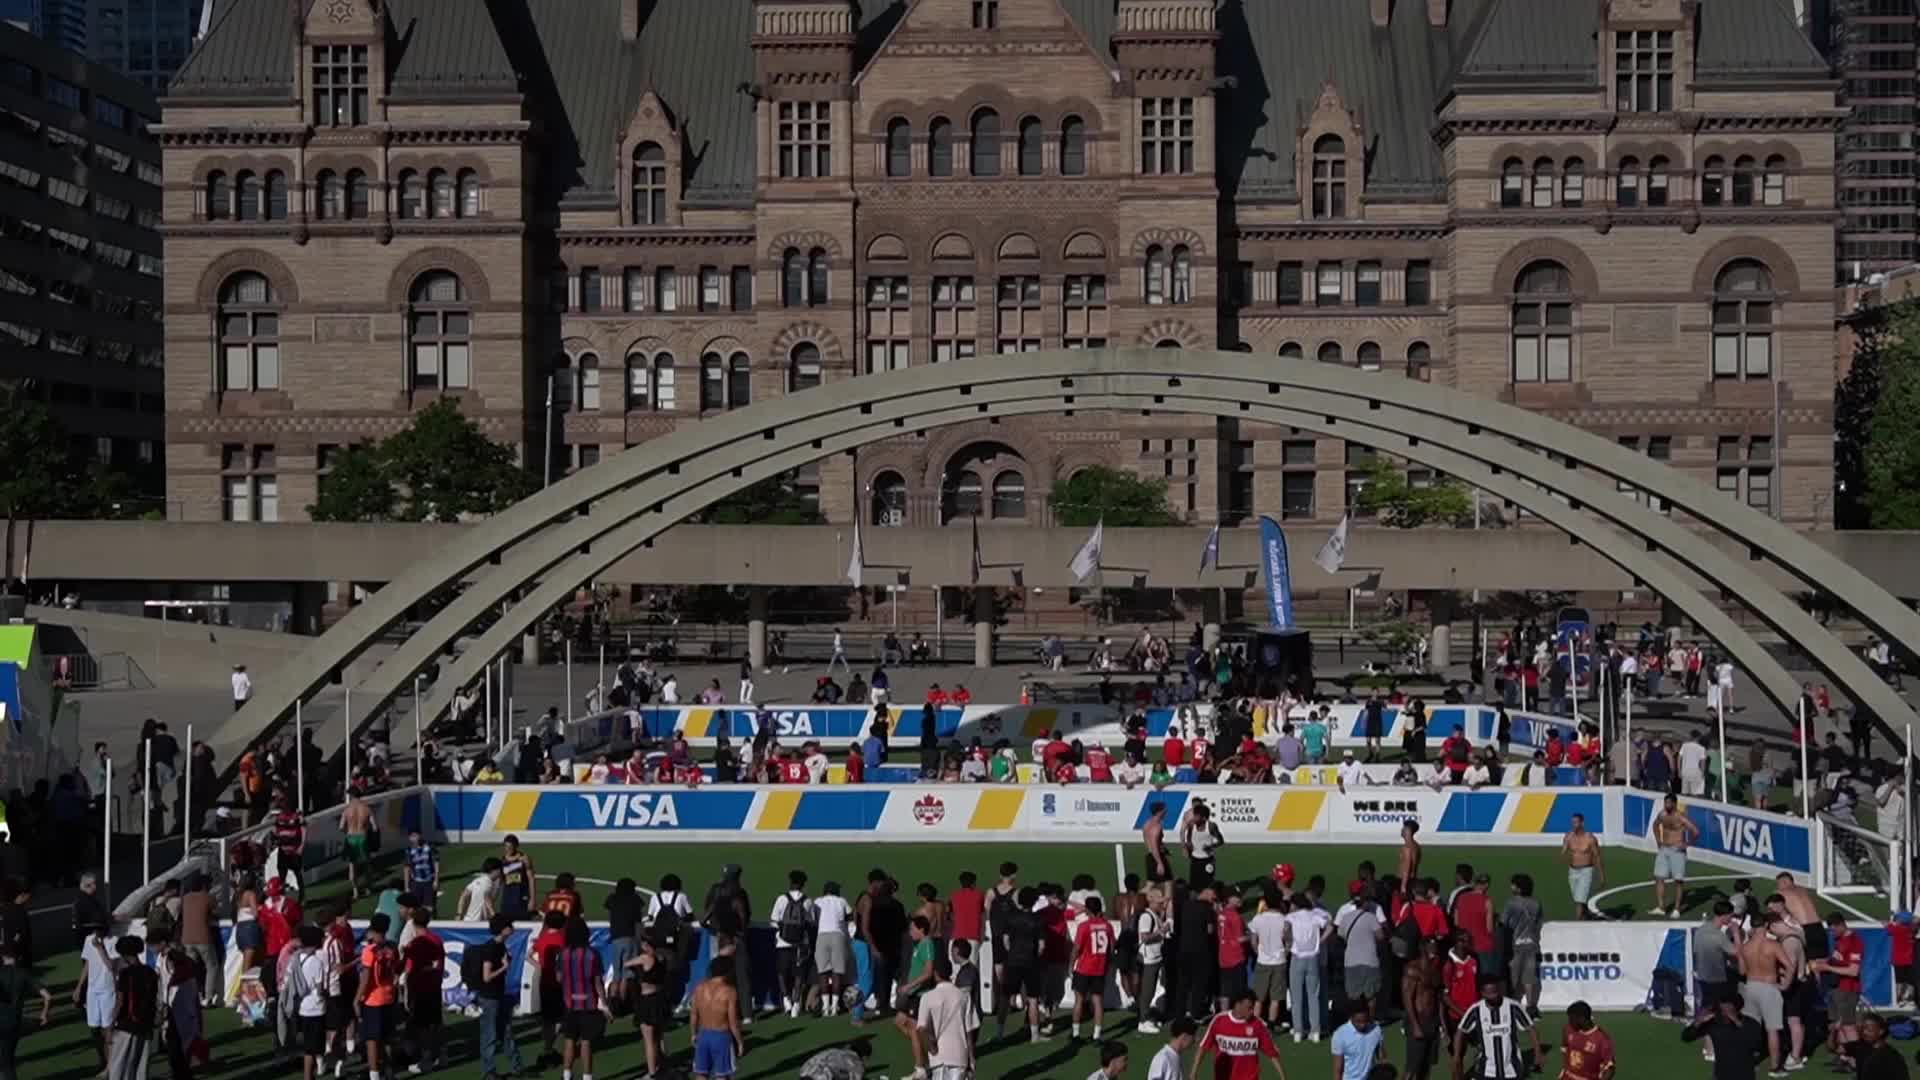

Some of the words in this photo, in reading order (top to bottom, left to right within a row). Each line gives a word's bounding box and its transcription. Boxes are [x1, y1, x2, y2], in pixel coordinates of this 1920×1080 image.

[743, 711, 813, 735] VSA
[1528, 720, 1558, 747] VIS
[578, 794, 679, 826] VISA
[1353, 800, 1380, 812] WE
[1353, 813, 1418, 823] TORONTO
[1220, 815, 1260, 823] CANADA
[1715, 813, 1775, 861] VISA
[1090, 930, 1109, 955] 19
[1540, 965, 1621, 981] RONTO
